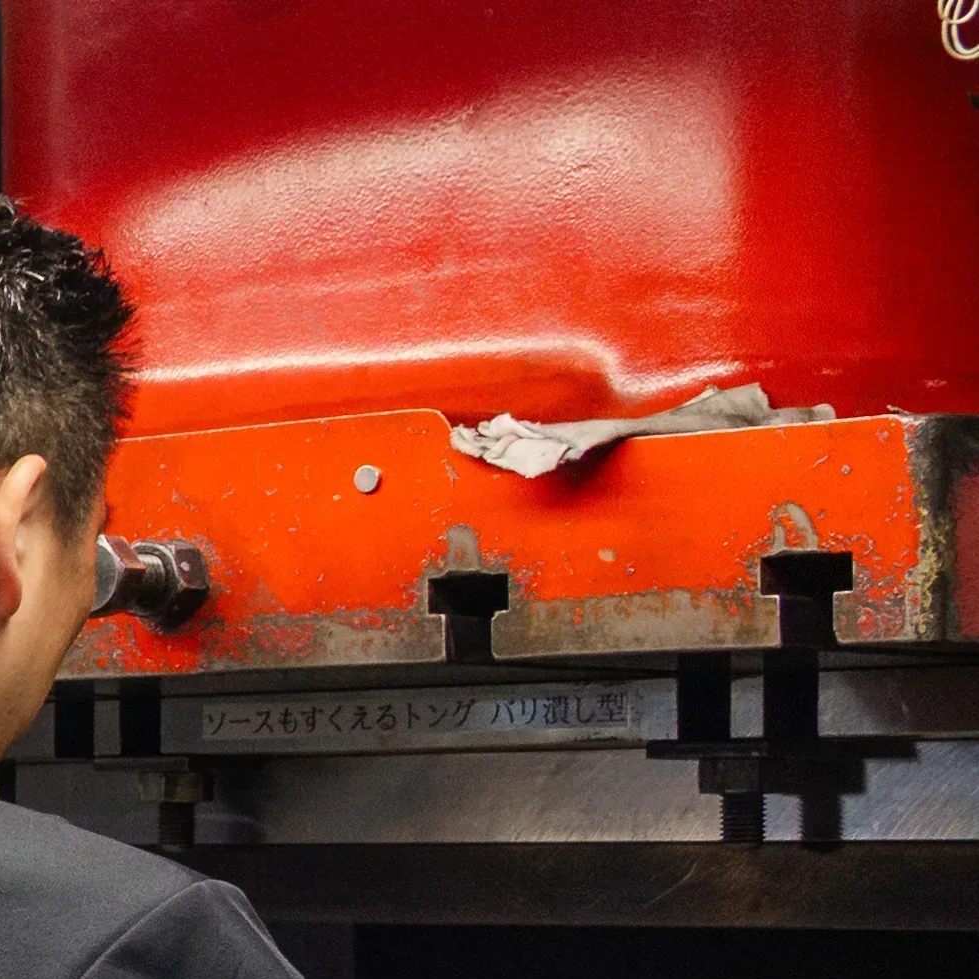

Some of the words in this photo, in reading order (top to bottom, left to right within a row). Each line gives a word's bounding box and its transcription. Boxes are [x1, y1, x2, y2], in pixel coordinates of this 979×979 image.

[207, 698, 478, 736] ソースもすくえるトング
